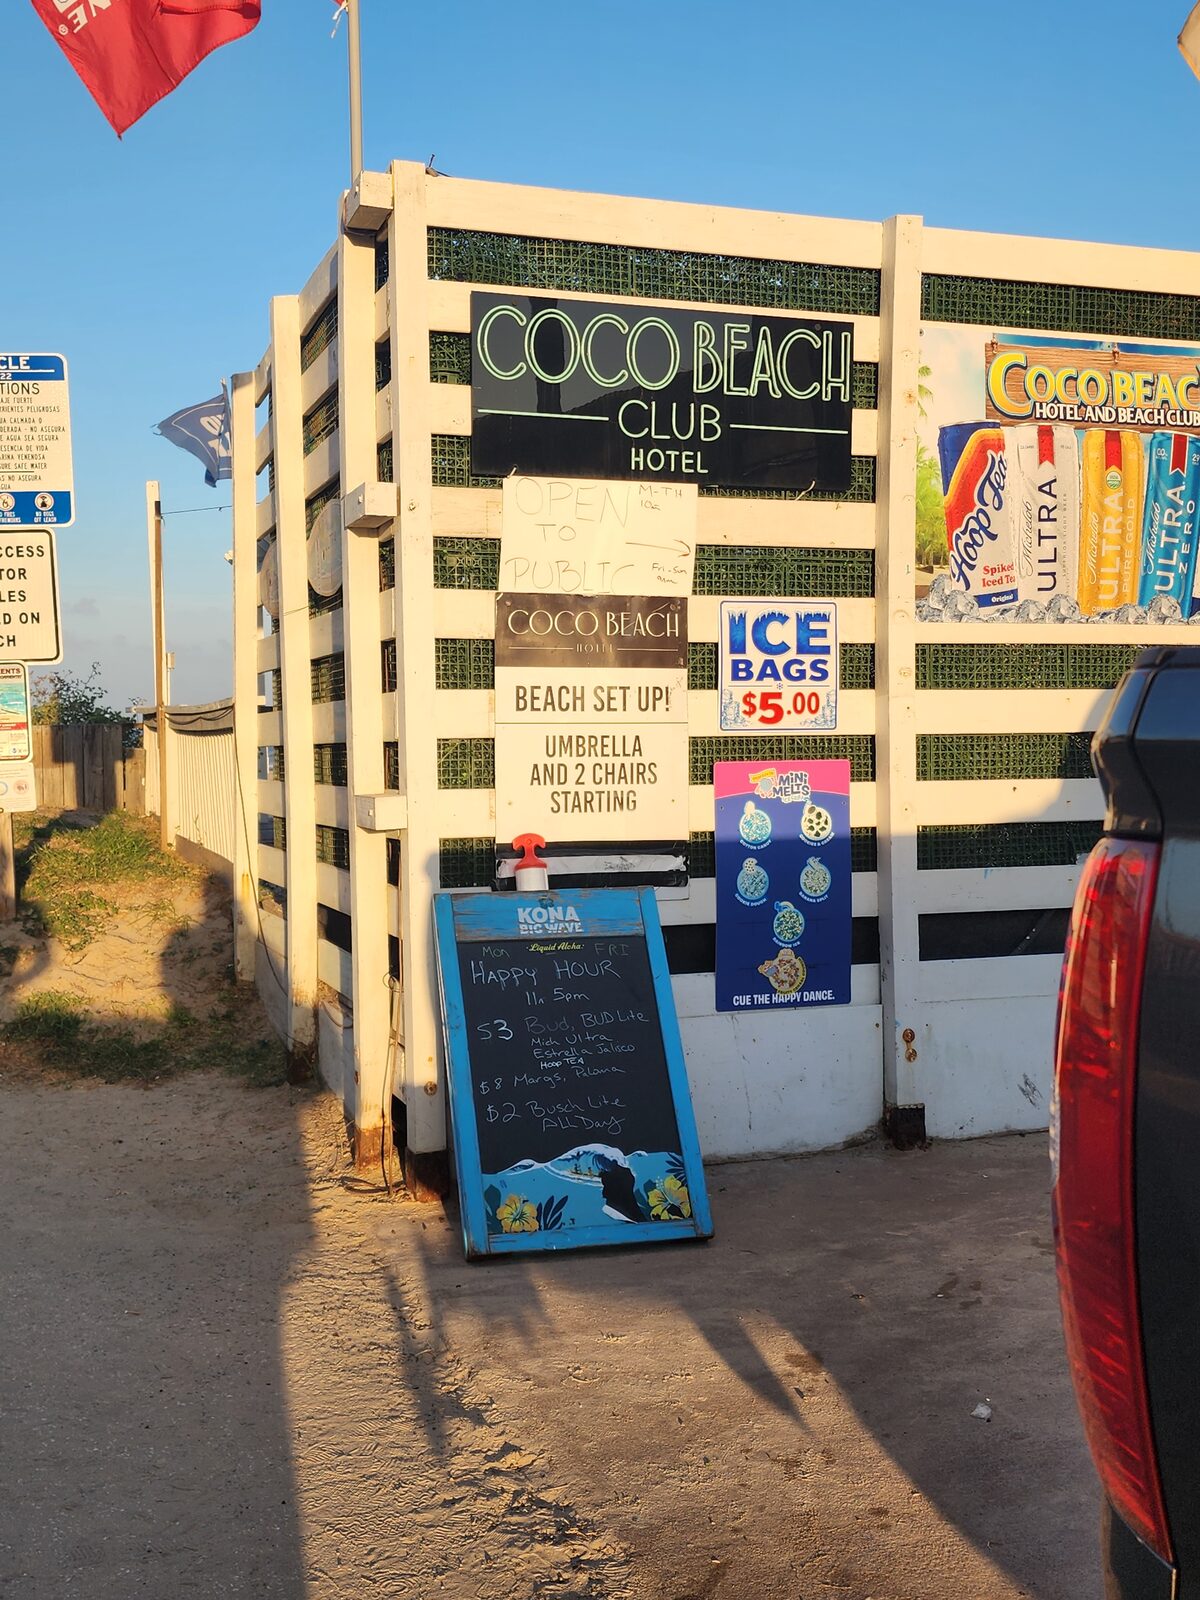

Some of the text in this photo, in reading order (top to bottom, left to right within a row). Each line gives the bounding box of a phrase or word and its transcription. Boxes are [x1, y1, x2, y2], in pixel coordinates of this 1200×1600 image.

[0, 356, 30, 370] CLE
[477, 305, 852, 403] COCO BEACH
[0, 382, 40, 395] TIONS
[988, 350, 1200, 417] COCO BEAC
[617, 399, 722, 442] CLUB
[1035, 400, 1200, 427] HOTEL AND BEACH CLUB
[631, 447, 709, 475] HOTEL
[515, 477, 631, 528] OPEN
[535, 523, 577, 542] TO
[1019, 500, 1034, 579] Michelob
[1037, 477, 1058, 592] ULTRA
[1098, 488, 1123, 600] ULTRA
[1143, 502, 1160, 575] Michelob
[1154, 482, 1186, 592] ULTRA
[1179, 499, 1196, 574] ZERO
[950, 507, 999, 592] Hoop
[1086, 511, 1099, 584] Michelob
[1122, 498, 1136, 593] PURE GOLD
[504, 556, 635, 595] PUBLIC
[982, 561, 1014, 577] Spiked
[982, 576, 1004, 588] Iced
[991, 592, 1014, 603] Original
[19, 612, 40, 625] ON
[507, 609, 679, 638] COCO BEACH
[728, 609, 831, 656] ICE
[730, 658, 829, 682] BAGS
[515, 685, 671, 712] BEACH SET UP!
[741, 690, 820, 725] $5.00
[545, 734, 643, 758] UMBRELLA
[530, 761, 658, 786] AND 2 CHAIRS
[550, 789, 637, 814] STARTING
[773, 783, 810, 797] MELTS
[517, 906, 581, 924] KONA
[519, 921, 584, 935] BIG WAVE
[528, 941, 582, 954] Liquid Aloha
[593, 943, 630, 956] FRI
[553, 959, 622, 980] HOUR
[553, 987, 590, 1003] 5pm
[733, 989, 836, 1006] CUE THE HAPPY DANCE.
[617, 1008, 649, 1023] Lite
[531, 1031, 613, 1047] Mich Ultra
[533, 1042, 636, 1059] Estrella Jalisco
[486, 1095, 626, 1123] $2 Busch Lite
[574, 1115, 627, 1135] Day
